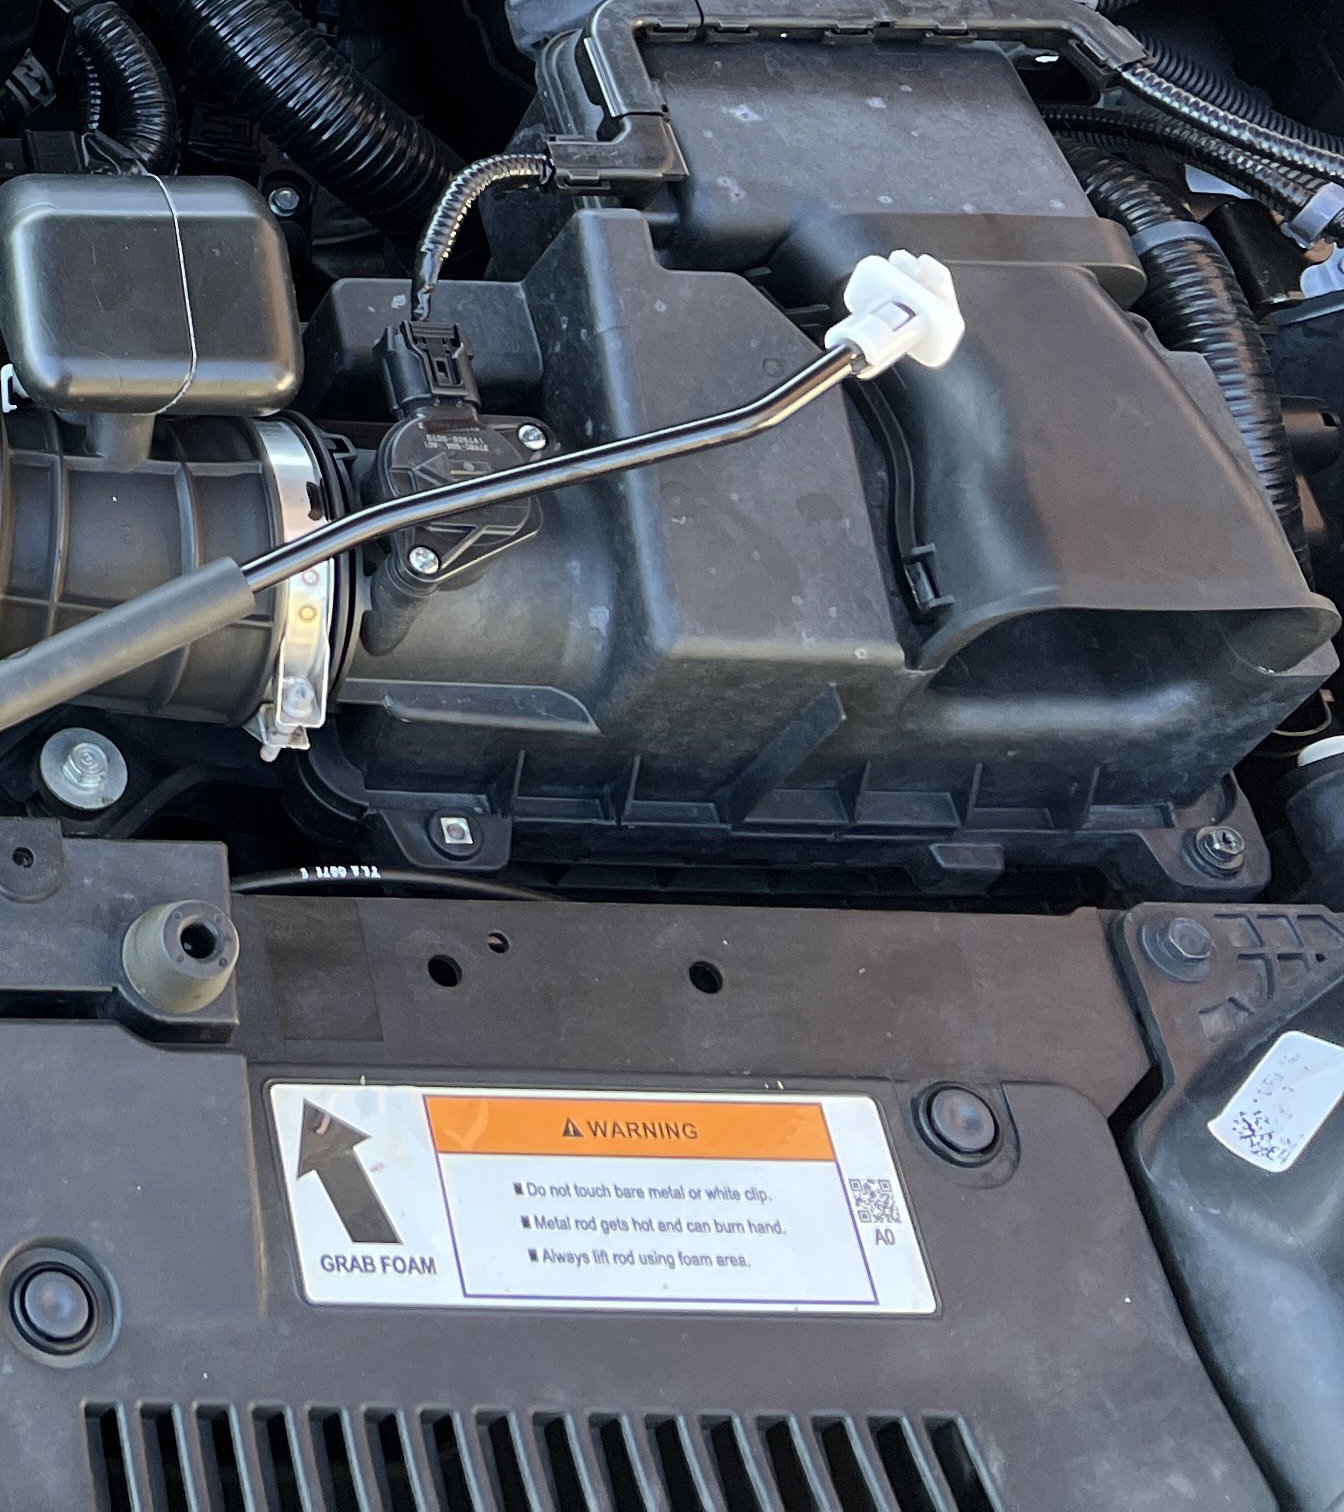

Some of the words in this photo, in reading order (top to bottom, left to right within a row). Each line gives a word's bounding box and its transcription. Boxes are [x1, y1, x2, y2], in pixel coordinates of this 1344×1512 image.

[588, 1119, 699, 1142] WARNING
[526, 1182, 546, 1198] Do
[549, 1183, 572, 1199] not
[574, 1183, 611, 1200] touch
[614, 1183, 645, 1200] bare
[648, 1184, 685, 1201] metal
[688, 1188, 702, 1201] or
[705, 1185, 741, 1202] white
[745, 1186, 773, 1205] clip.
[533, 1215, 571, 1232] Metal
[574, 1216, 596, 1233] rod
[600, 1218, 629, 1236] gets
[633, 1218, 655, 1233] hot
[658, 1218, 682, 1234] and
[686, 1222, 710, 1234] can
[714, 1218, 744, 1234] burn
[747, 1219, 786, 1236] hand.
[320, 1255, 377, 1276] GRAB
[380, 1256, 437, 1276] FOAM
[543, 1249, 590, 1269] Always
[593, 1250, 610, 1267] lift
[613, 1251, 635, 1267] rod
[638, 1251, 675, 1271] using
[678, 1251, 712, 1268] foam
[716, 1255, 752, 1269] area.
